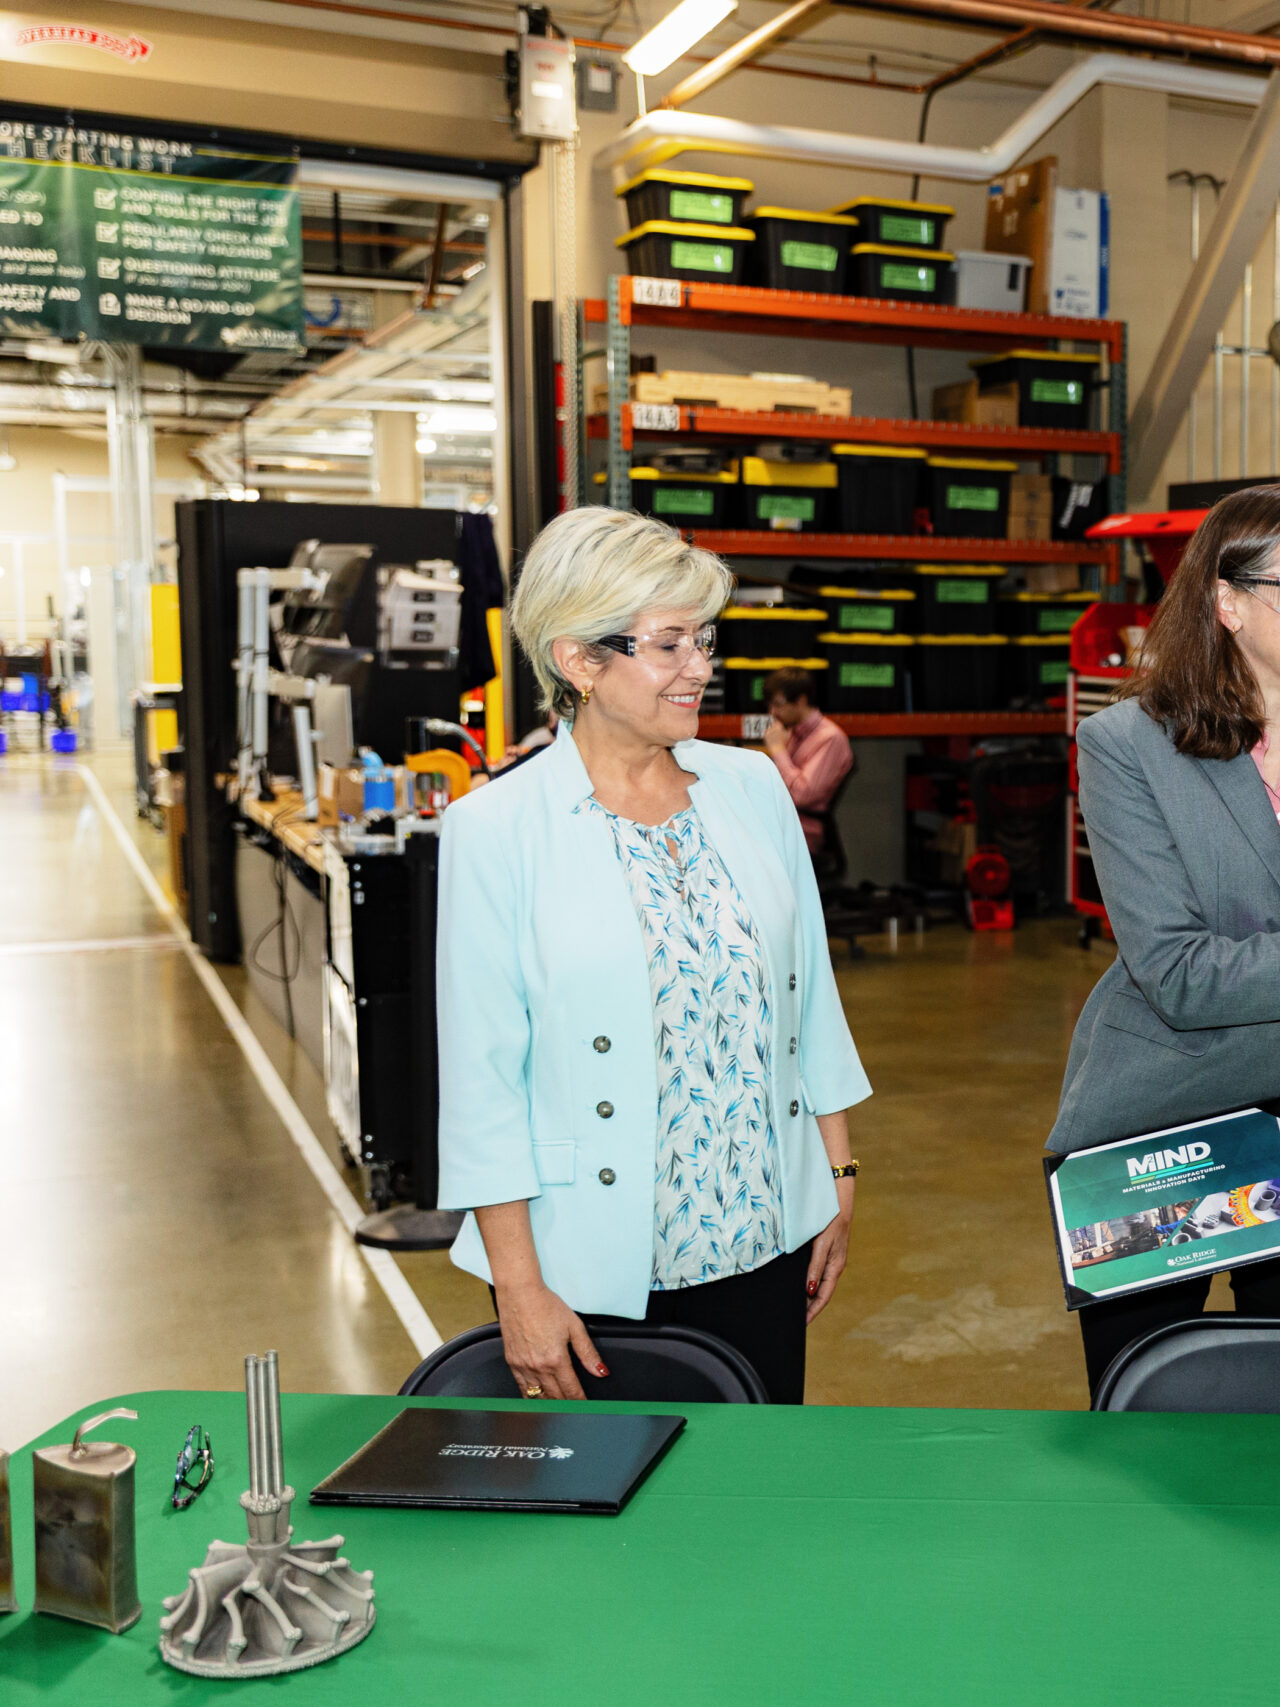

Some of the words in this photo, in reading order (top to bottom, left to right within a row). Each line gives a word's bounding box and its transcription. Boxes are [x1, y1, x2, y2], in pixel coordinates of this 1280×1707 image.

[42, 125, 134, 150] STARTING
[138, 138, 193, 157] WORK
[187, 193, 214, 208] THE
[216, 196, 257, 213] RIGHT
[23, 211, 43, 226] TO
[121, 202, 152, 217] AND
[155, 206, 198, 221] TOOLS
[202, 209, 230, 224] FOR
[233, 212, 259, 227] THE
[122, 236, 152, 250] FOR
[154, 240, 205, 255] SAFETY
[204, 230, 250, 245] CHECK
[124, 257, 216, 278] QUESTIONING
[217, 266, 281, 283] ATTITUDE
[49, 287, 81, 301] AND
[125, 293, 165, 310] MAKE
[167, 297, 178, 310] A
[125, 307, 192, 325] DECISION
[1122, 1179, 1161, 1193] MATERIALS
[1167, 1164, 1226, 1183] MANUFACTURING
[1145, 1179, 1187, 1193] INNOVATION
[1188, 1175, 1205, 1183] DAYS
[1175, 1255, 1191, 1263] OAK
[1192, 1248, 1216, 1258] RIDGE
[439, 1448, 501, 1458] RIDGE
[503, 1450, 545, 1459] OAK
